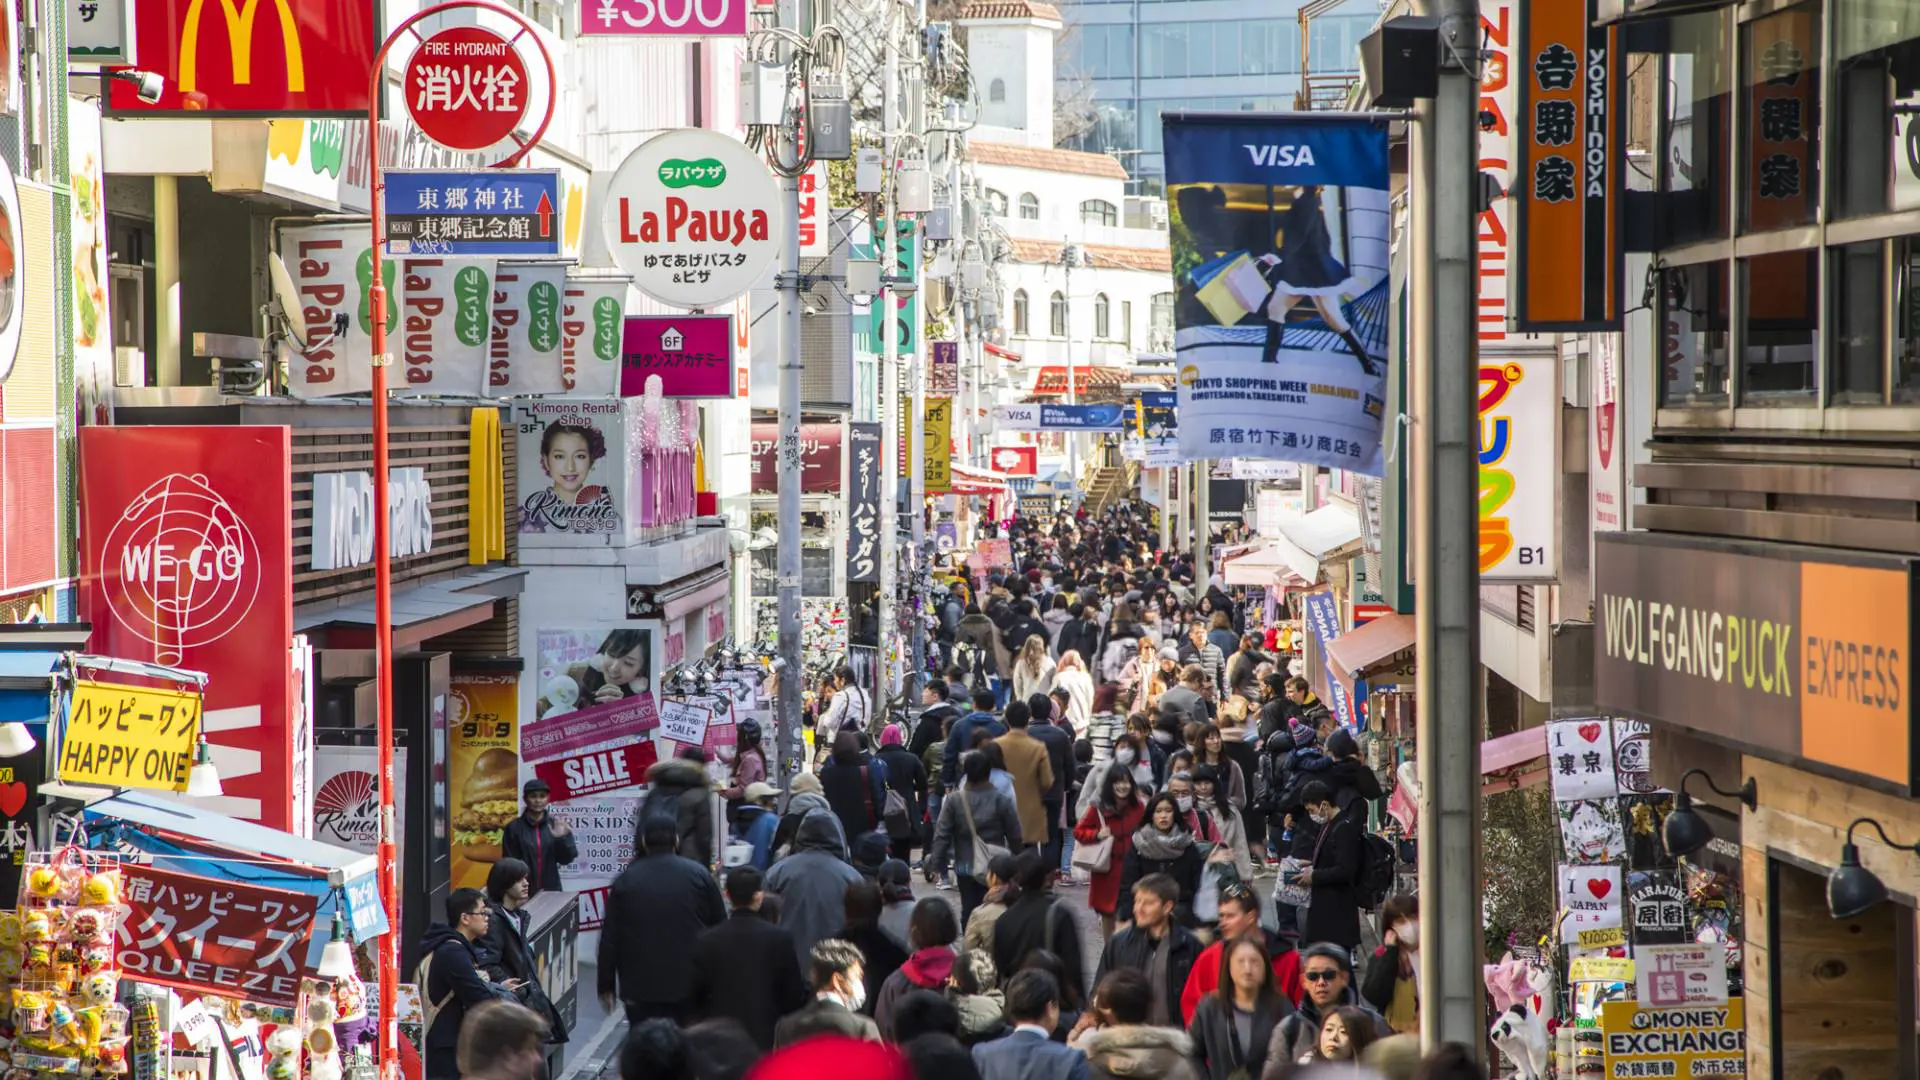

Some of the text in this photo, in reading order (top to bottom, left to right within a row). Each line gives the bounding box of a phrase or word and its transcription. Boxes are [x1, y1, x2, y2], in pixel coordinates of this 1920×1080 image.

[425, 42, 508, 57] FIRE HYDRANT
[416, 64, 520, 112] 消火栓
[1534, 43, 1578, 204] 吉野家
[1243, 144, 1315, 167] VISA
[416, 187, 525, 210] 東郷神社
[417, 216, 531, 240] 東郷記念館
[619, 196, 769, 247] La Pausa
[663, 336, 680, 347] 6F
[1191, 377, 1223, 390] TOKYO
[1225, 378, 1278, 392] SHOPPING
[1279, 380, 1308, 393] WEEK
[532, 402, 620, 414] Kimono Rental
[1007, 410, 1032, 421] VISA
[520, 424, 538, 434] 3F
[560, 415, 592, 429] Shop
[1209, 427, 1362, 457] 原宿竹下通り商店会
[1519, 547, 1544, 564] B1
[1603, 593, 1792, 697] WOLFGANG PUCK
[1807, 635, 1901, 712] EXPRESS
[73, 697, 197, 738] ハッピーワン
[671, 723, 692, 737] SALE
[63, 740, 190, 784] HAPPY ONE
[563, 749, 631, 790] SALE
[1558, 750, 1602, 775] 東京
[592, 803, 614, 815] shop
[315, 805, 379, 842] Kimon
[586, 834, 636, 844] 10:00-19:3
[1567, 878, 1577, 894] I
[1630, 885, 1690, 905] HARAJUKU
[118, 874, 311, 927] 宿ハッピーワン
[1570, 901, 1608, 911] JAPAN
[1575, 914, 1601, 922] 日本
[1637, 905, 1682, 925] 原宿
[116, 950, 299, 997] QUEEZE
[1653, 1010, 1727, 1028] MONEY
[1615, 1061, 1676, 1077] 外貨両替
